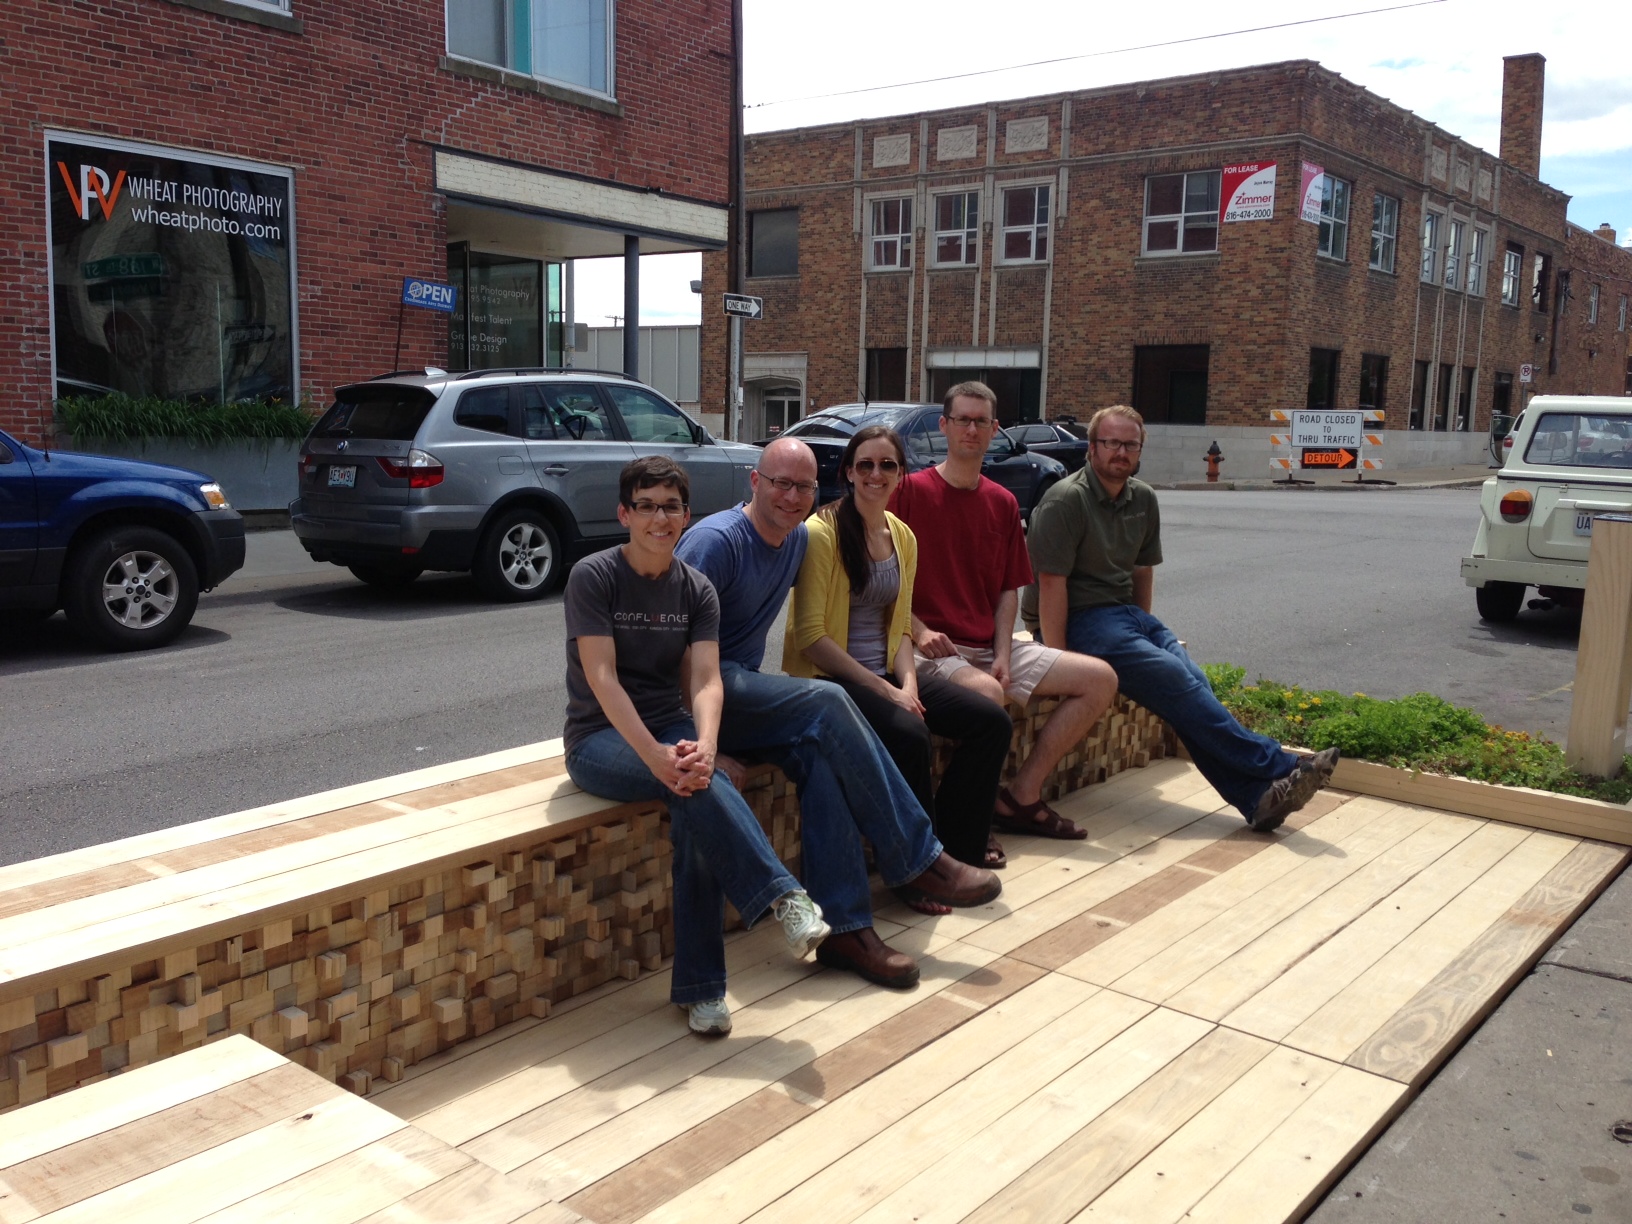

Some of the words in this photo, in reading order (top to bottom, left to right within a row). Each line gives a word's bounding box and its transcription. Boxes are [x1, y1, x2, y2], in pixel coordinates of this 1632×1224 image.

[1224, 166, 1237, 174] FOR
[1238, 165, 1259, 173] LEASE
[127, 175, 178, 203] WHEAT
[183, 183, 283, 218] PHOTOGRAPHY
[1235, 192, 1272, 205] Zimmer
[1225, 209, 1272, 220] 816-474-2000
[131, 205, 281, 240] wheatphoto.com
[408, 281, 452, 304] OPEN
[480, 285, 530, 300] Photography
[728, 300, 740, 310] ONE
[740, 302, 752, 312] WAY
[488, 314, 512, 325] Talent
[480, 333, 507, 346] Design
[1299, 414, 1321, 424] ROAD
[1325, 415, 1356, 424] CLOSED
[1322, 425, 1332, 433] TO
[1298, 434, 1319, 444] THRU
[1323, 435, 1355, 444] TRAFFIC
[1307, 453, 1343, 462] DETOUR
[614, 612, 689, 623] CONFLUENCE
